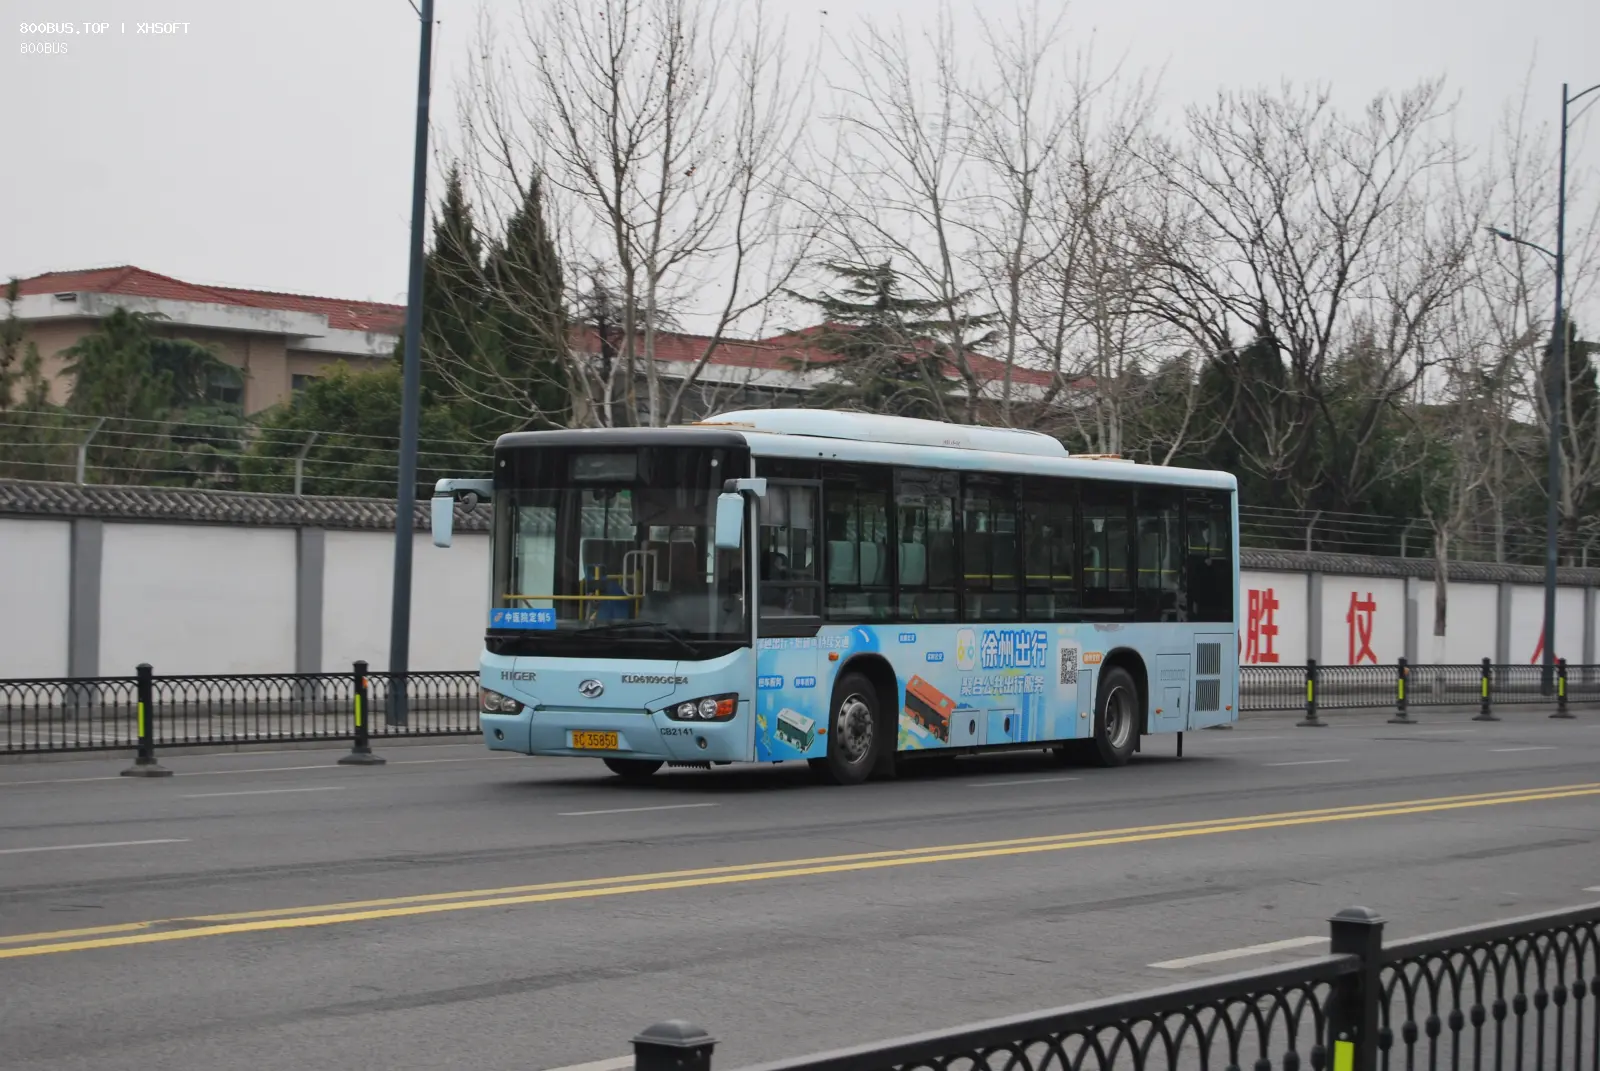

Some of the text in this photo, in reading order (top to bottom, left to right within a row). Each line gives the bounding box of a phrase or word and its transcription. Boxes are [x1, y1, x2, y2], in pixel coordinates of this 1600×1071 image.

[1245, 588, 1377, 664] 胜 仗
[981, 631, 1048, 668] 徐州出行
[500, 671, 537, 682] HIGER
[960, 675, 1045, 696] 聚合公共出行服务
[587, 733, 617, 747] 35850
[660, 727, 694, 736] CB2141
